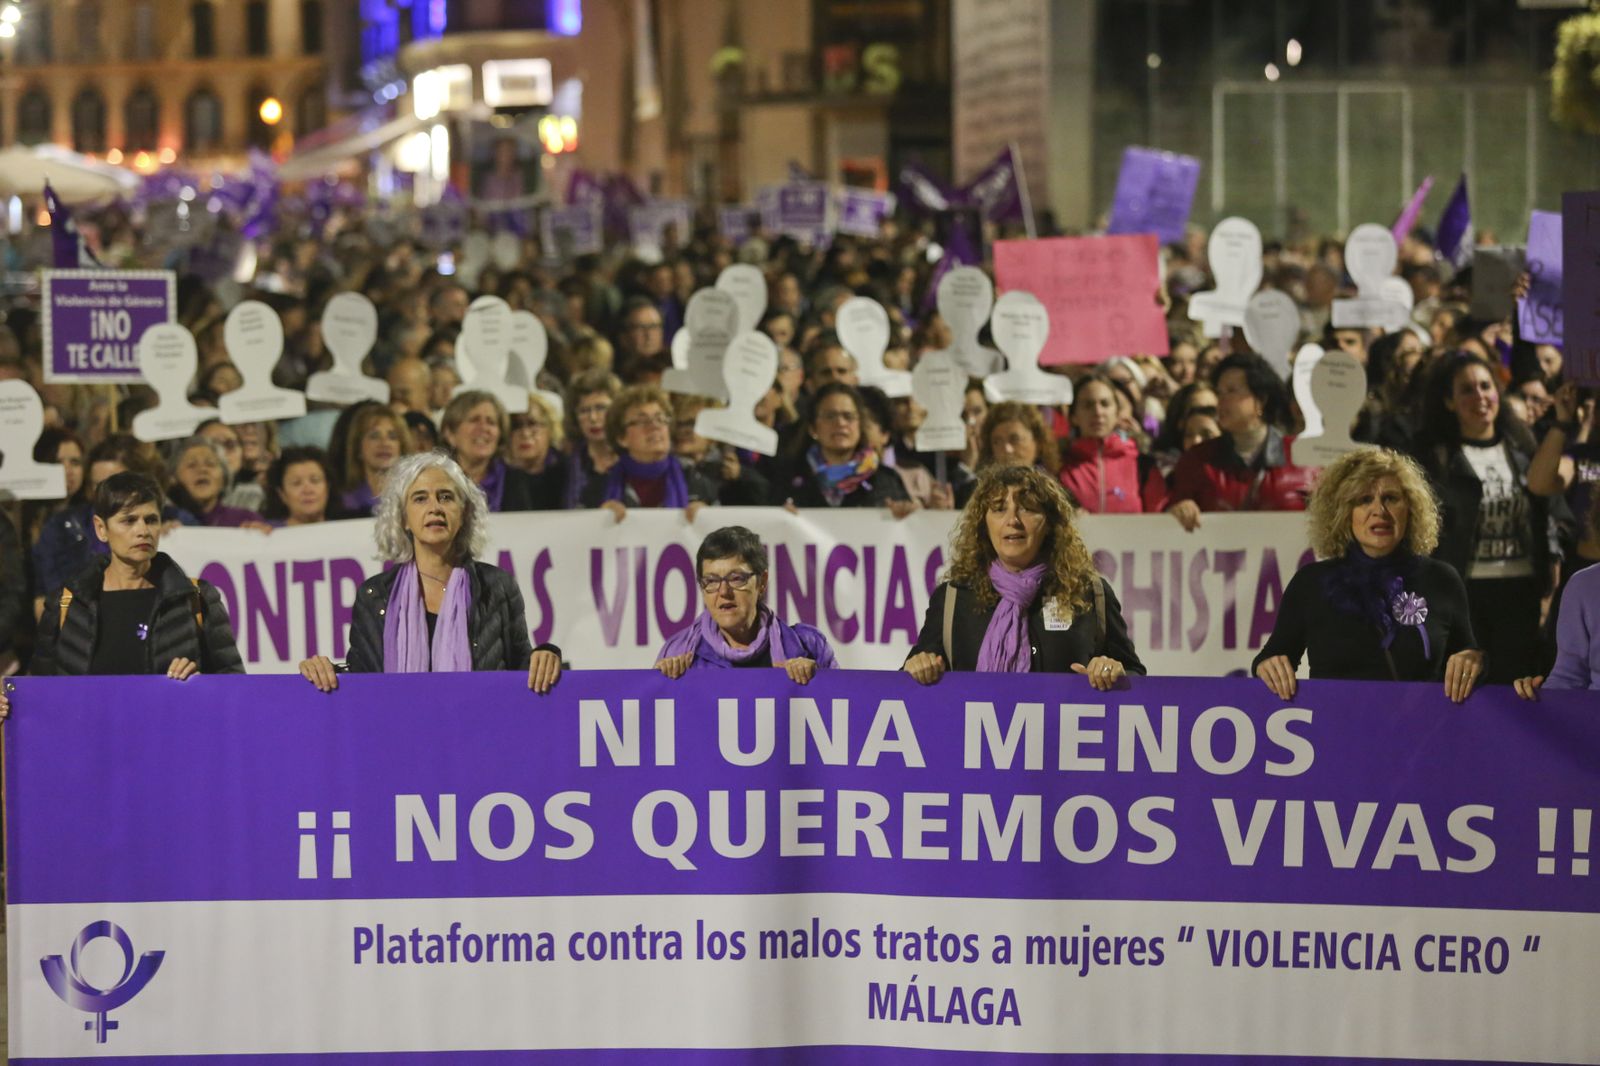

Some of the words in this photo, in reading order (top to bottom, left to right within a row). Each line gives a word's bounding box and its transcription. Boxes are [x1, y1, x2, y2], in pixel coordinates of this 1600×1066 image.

[55, 295, 106, 307] Violencia
[108, 296, 121, 307] de
[125, 295, 164, 308] Género
[90, 310, 131, 341] ¡NO
[67, 343, 88, 369] TE
[90, 343, 140, 369] CALLE
[590, 543, 944, 646] VIONCIA
[579, 698, 676, 767] NI
[717, 698, 926, 769] UNA
[964, 701, 1316, 777] MENOS
[297, 811, 351, 880] ¡¡
[395, 790, 595, 863] NOS
[631, 789, 1178, 871] QUEREMOS
[1212, 798, 1497, 874] VIVAS
[1537, 807, 1593, 877] !!
[354, 923, 555, 964] Plataforma
[568, 923, 683, 963] contra
[696, 920, 746, 961] los
[760, 917, 860, 960] malos
[873, 924, 979, 963] tratos
[992, 934, 1012, 964] a
[1027, 924, 1165, 977] mujeres
[1208, 930, 1400, 970] VIOLENCIA
[1414, 935, 1509, 974] CERO
[868, 974, 1021, 1026] MÁLAGA
